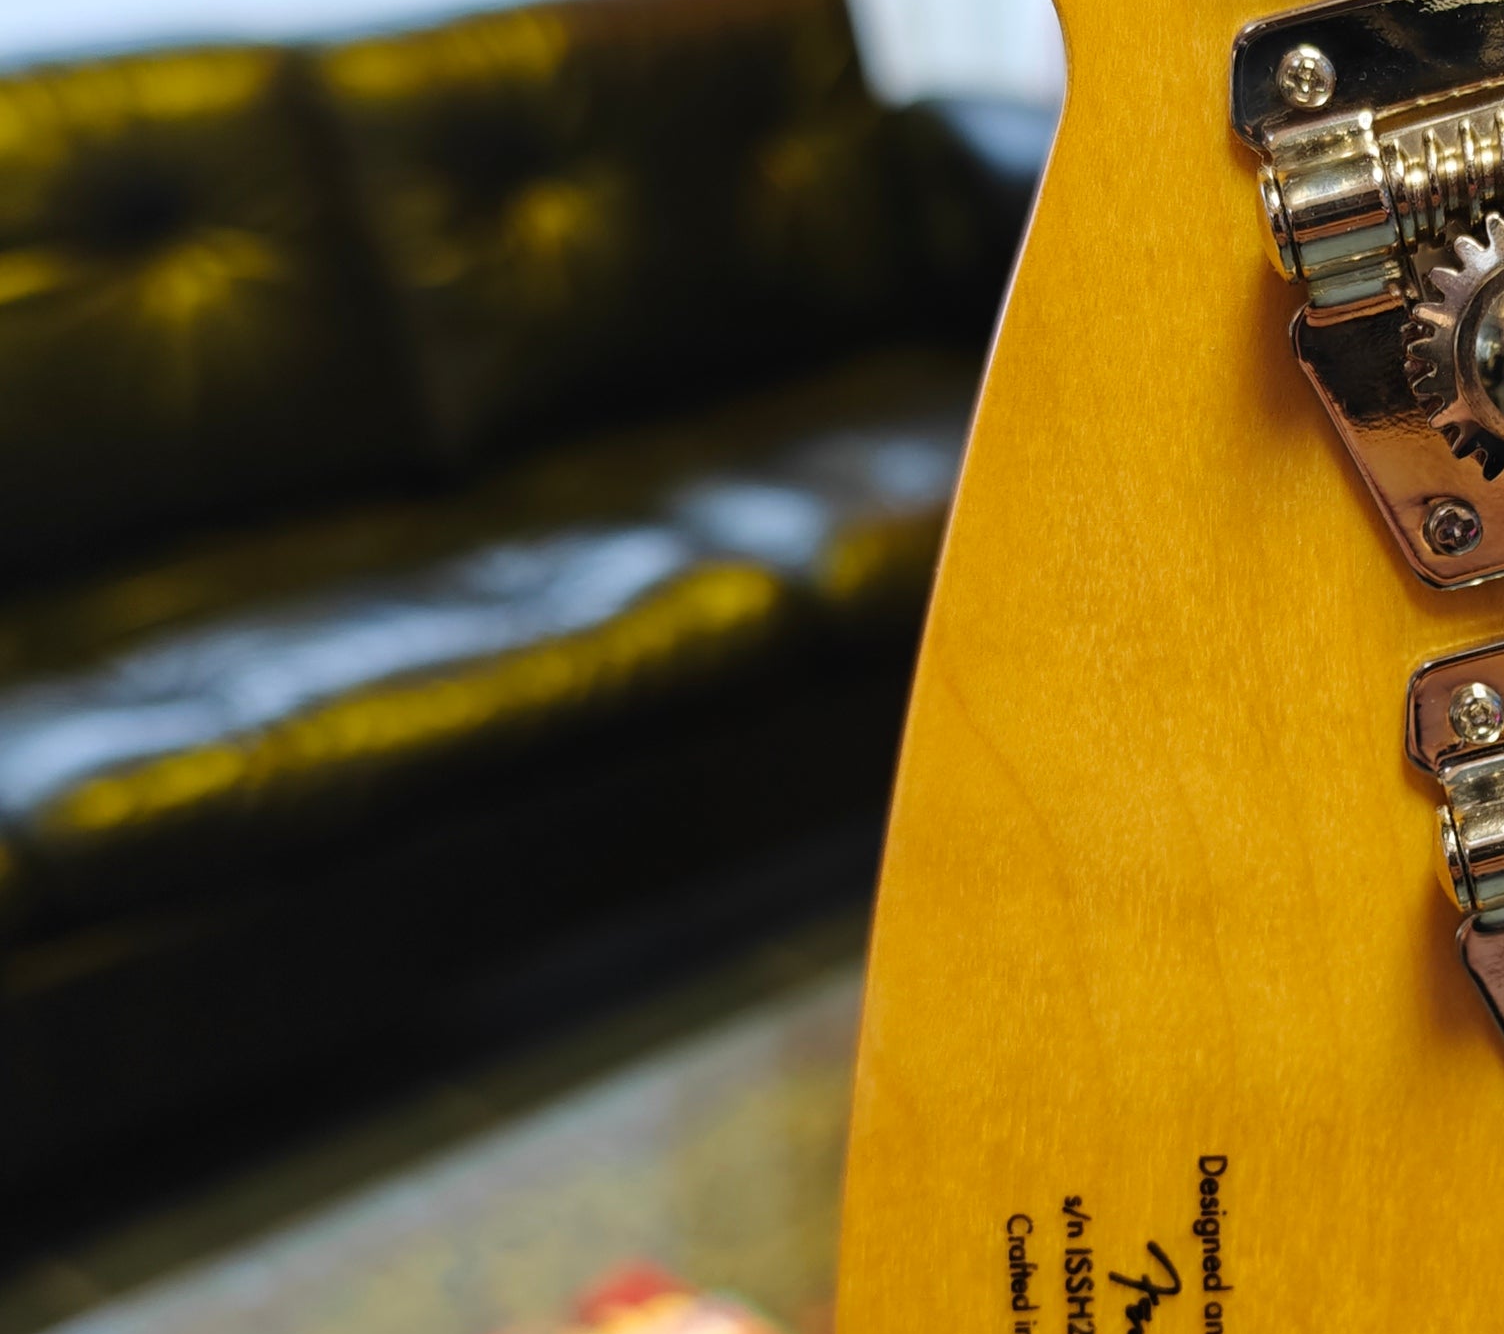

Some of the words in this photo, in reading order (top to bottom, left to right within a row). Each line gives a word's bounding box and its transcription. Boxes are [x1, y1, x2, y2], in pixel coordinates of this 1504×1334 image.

[1006, 1213, 1039, 1313] Crafted
[1062, 1195, 1092, 1238] s/n
[1193, 1155, 1233, 1292] Designed
